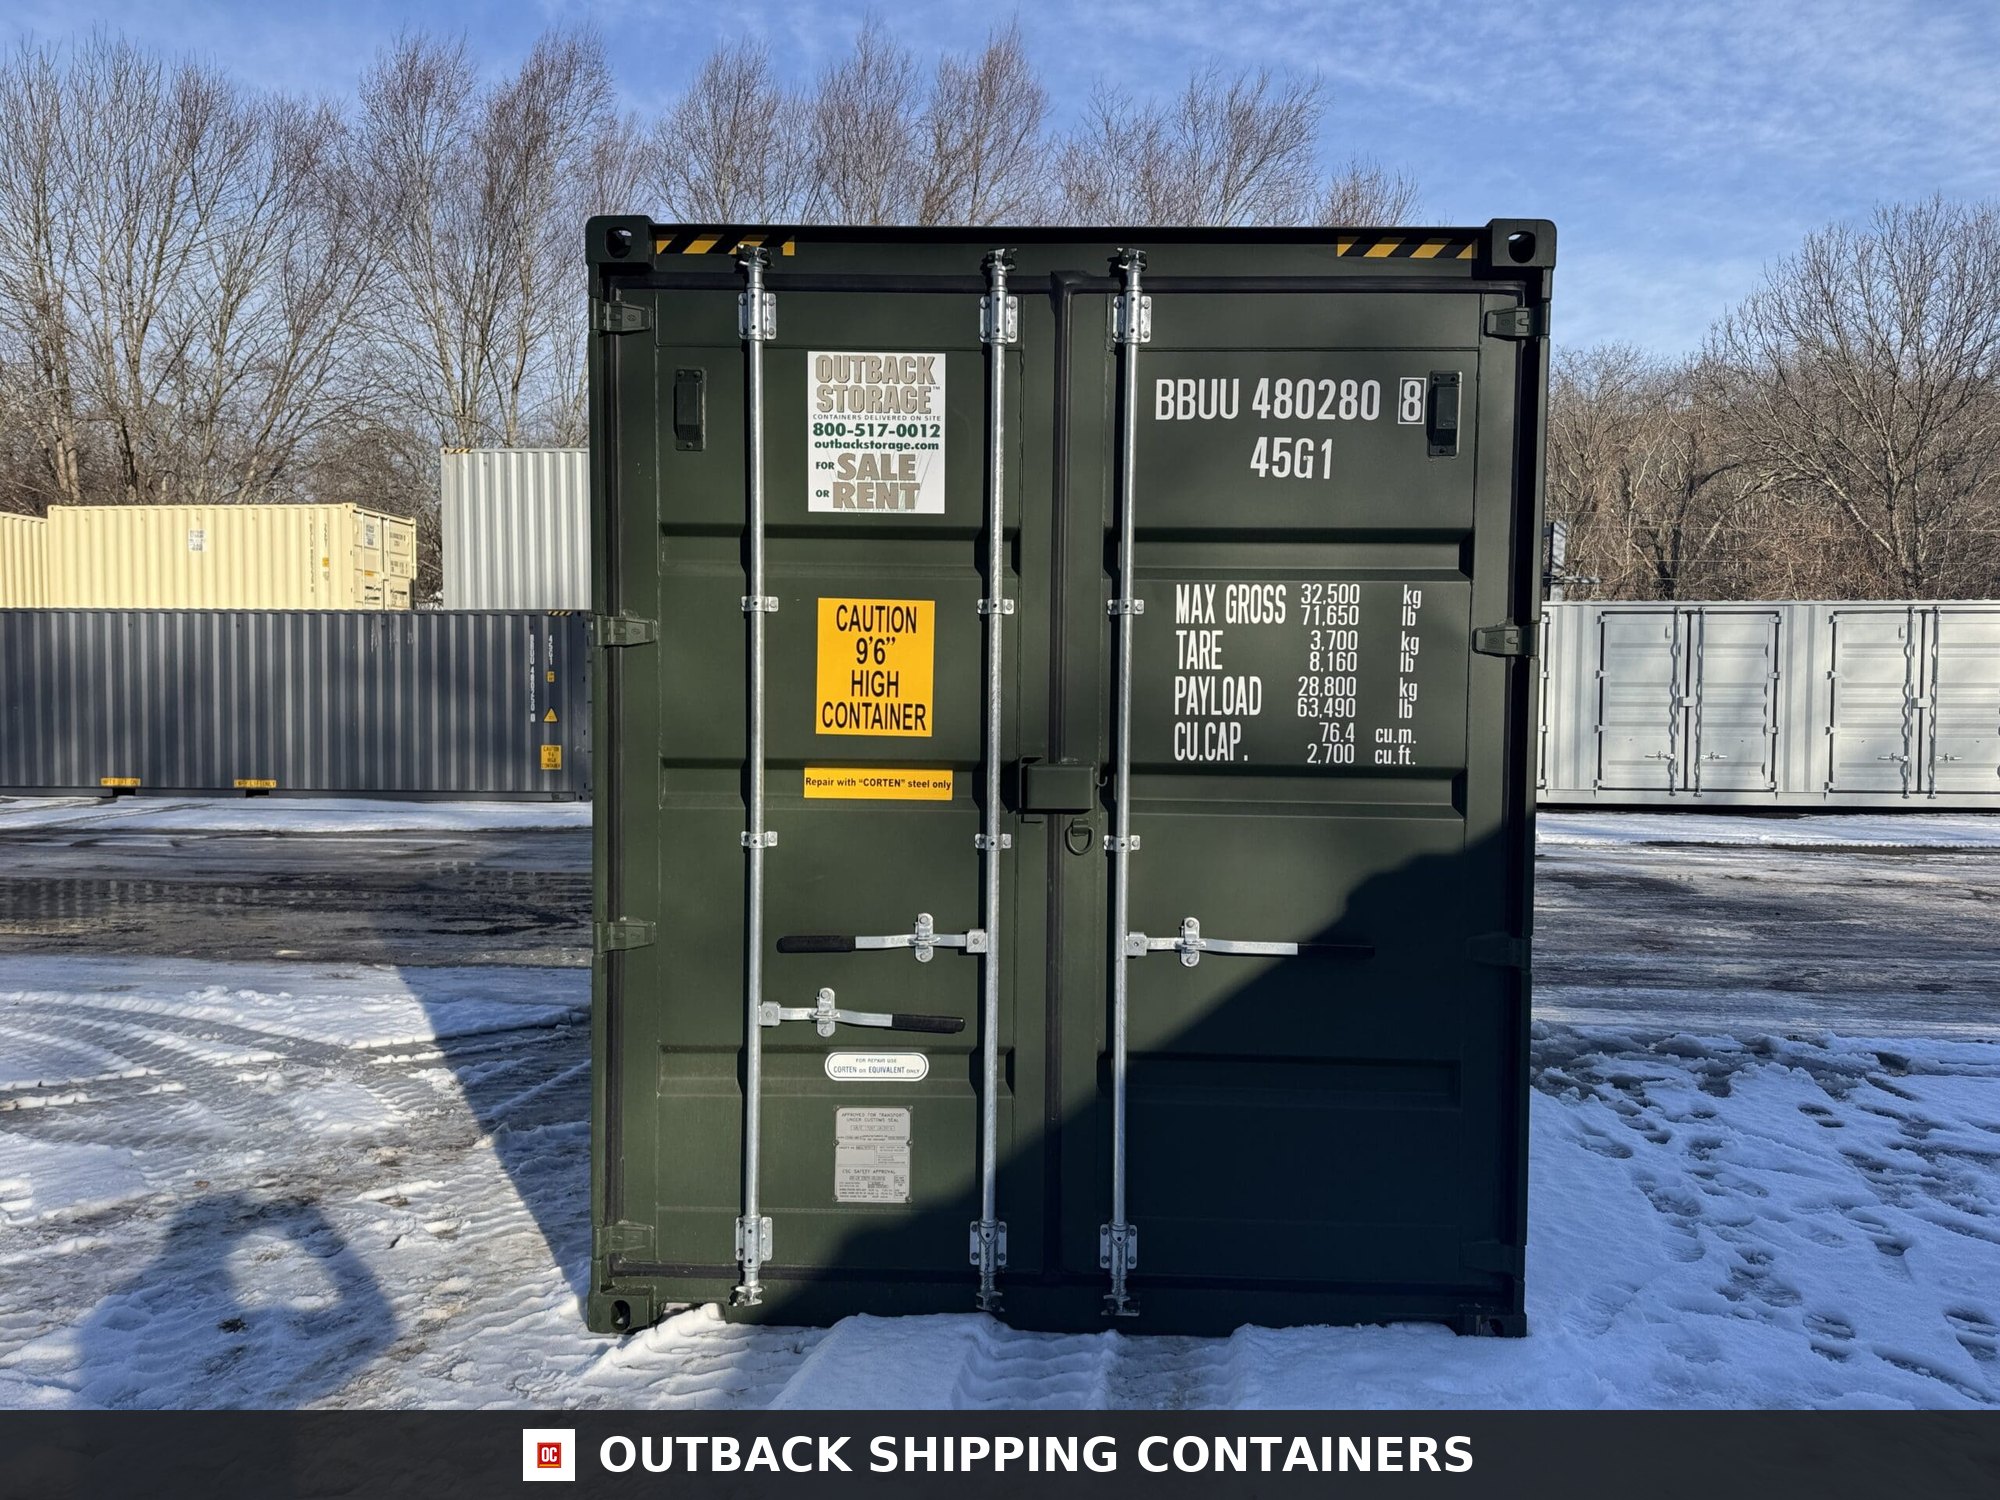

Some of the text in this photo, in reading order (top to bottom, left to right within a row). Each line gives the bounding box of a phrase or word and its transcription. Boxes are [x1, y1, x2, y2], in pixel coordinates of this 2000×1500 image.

[815, 355, 935, 385] OUTBACK
[816, 384, 932, 414] STORAGE
[1155, 377, 1423, 422] BBUU 480280 8
[813, 422, 940, 438] 800-517-0012
[814, 439, 939, 451] outbackstorage.com
[1250, 436, 1333, 479] 45G1
[816, 452, 916, 481] FOR SALE
[816, 482, 920, 510] OR RENT
[1176, 583, 1422, 624] MAX GROSS 32,500 kg
[1300, 605, 1416, 627] 71,650 lb
[836, 604, 917, 634] CAUTION
[856, 636, 896, 665] 9'6"
[1176, 630, 1419, 670] TARE 3,700 kg
[1309, 651, 1414, 673] 8,160 lb
[851, 670, 899, 698] HIGH
[1174, 676, 1418, 716] PAYLOAD 28,800 kg
[822, 702, 926, 731] CONTAINER
[1297, 698, 1413, 719] 63,490 lb
[1318, 722, 1355, 743] 76.4
[1375, 727, 1417, 744] cu.m.
[1307, 743, 1416, 765] 2,700 cu.ft.
[805, 777, 951, 791] Repair with "CORTEN" steel only
[868, 1066, 905, 1074] EQUIVALENT
